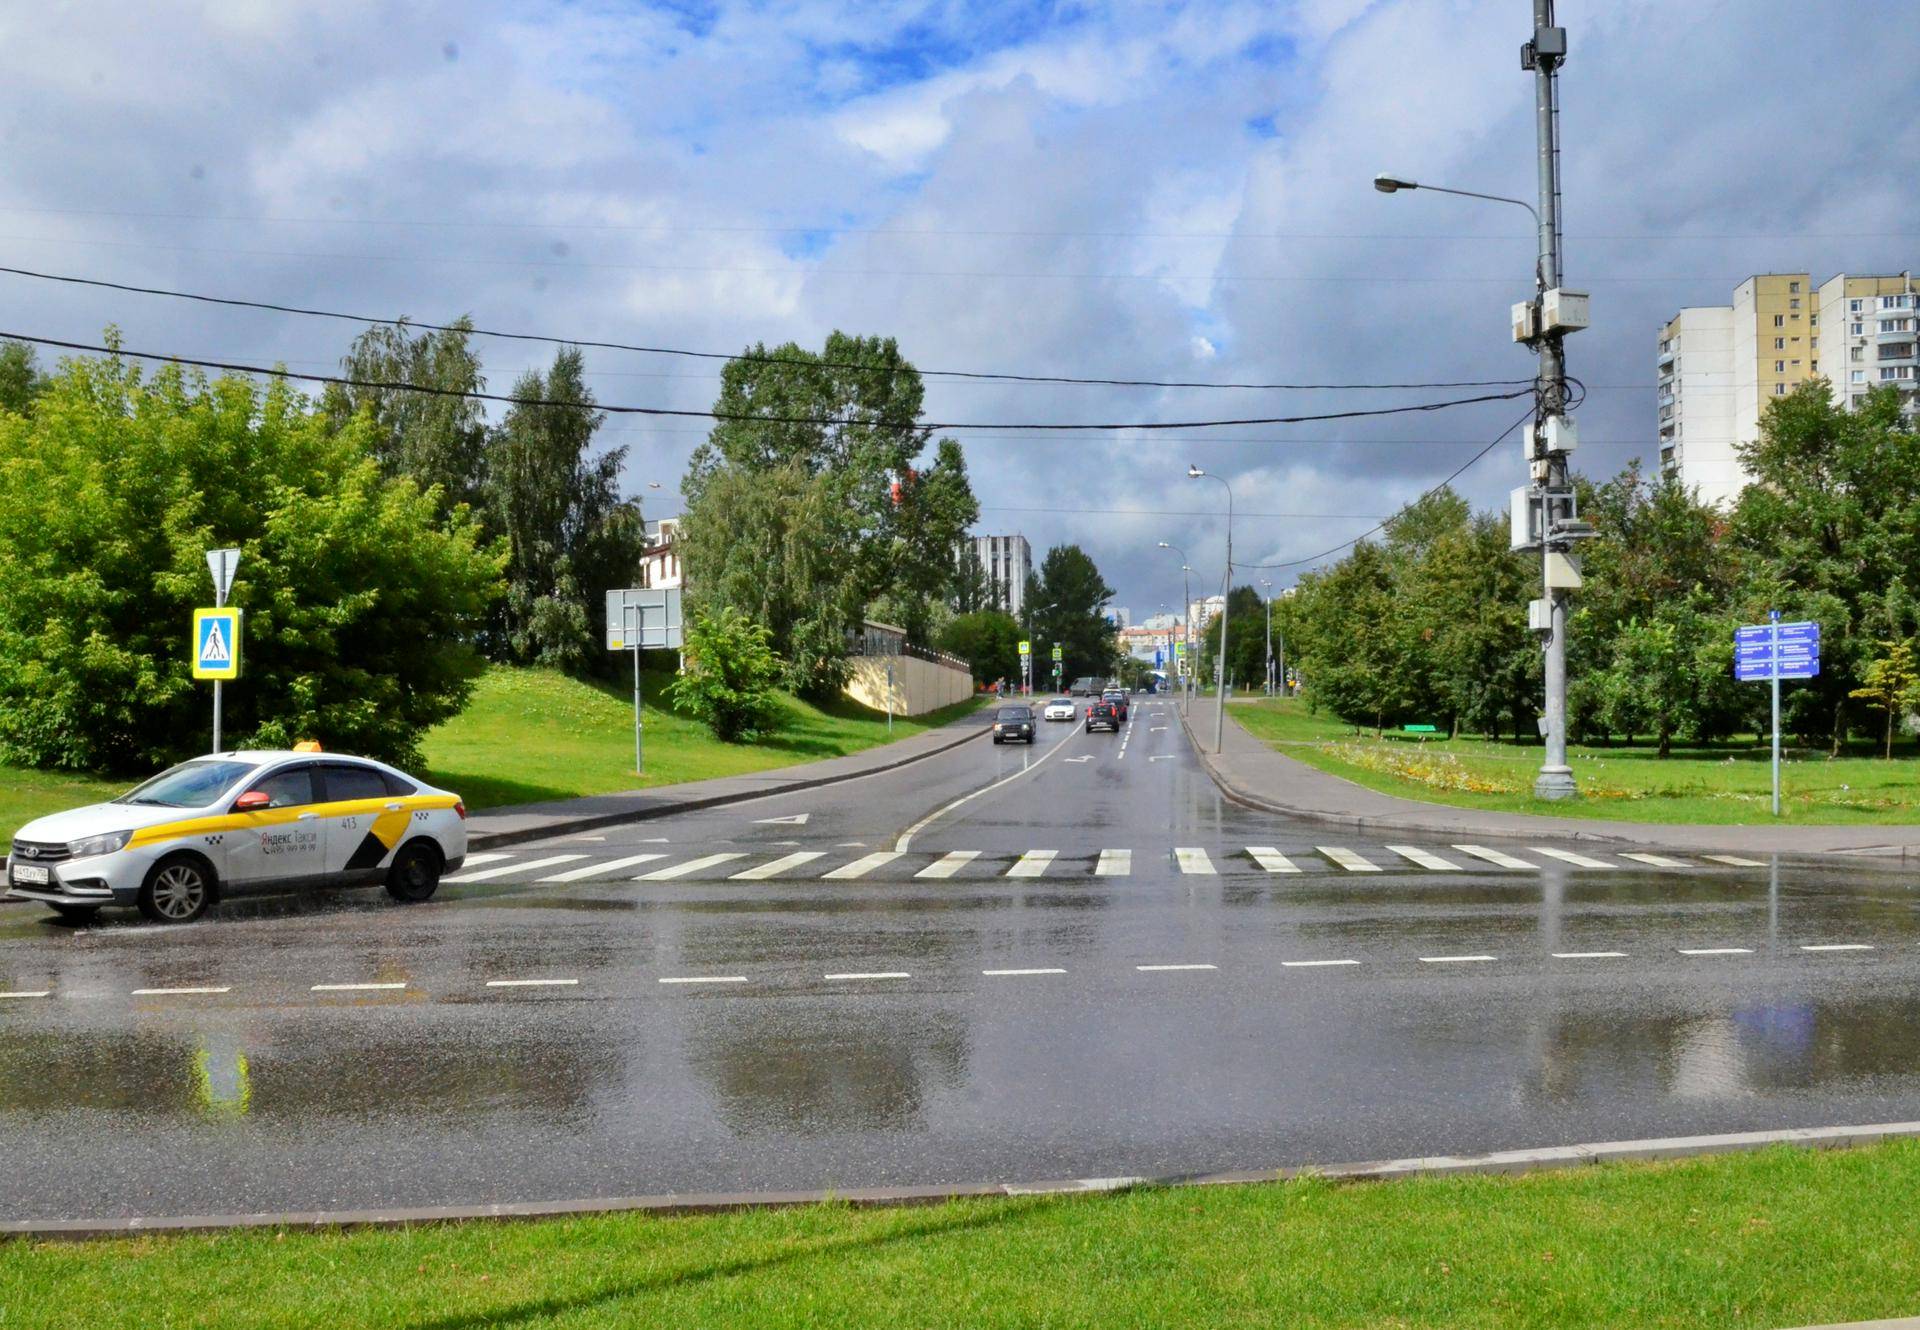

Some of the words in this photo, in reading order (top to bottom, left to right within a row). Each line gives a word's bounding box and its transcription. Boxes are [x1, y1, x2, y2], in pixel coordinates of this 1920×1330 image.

[341, 817, 356, 830] 413
[261, 832, 292, 847] Яндекс
[294, 830, 317, 843] Такси
